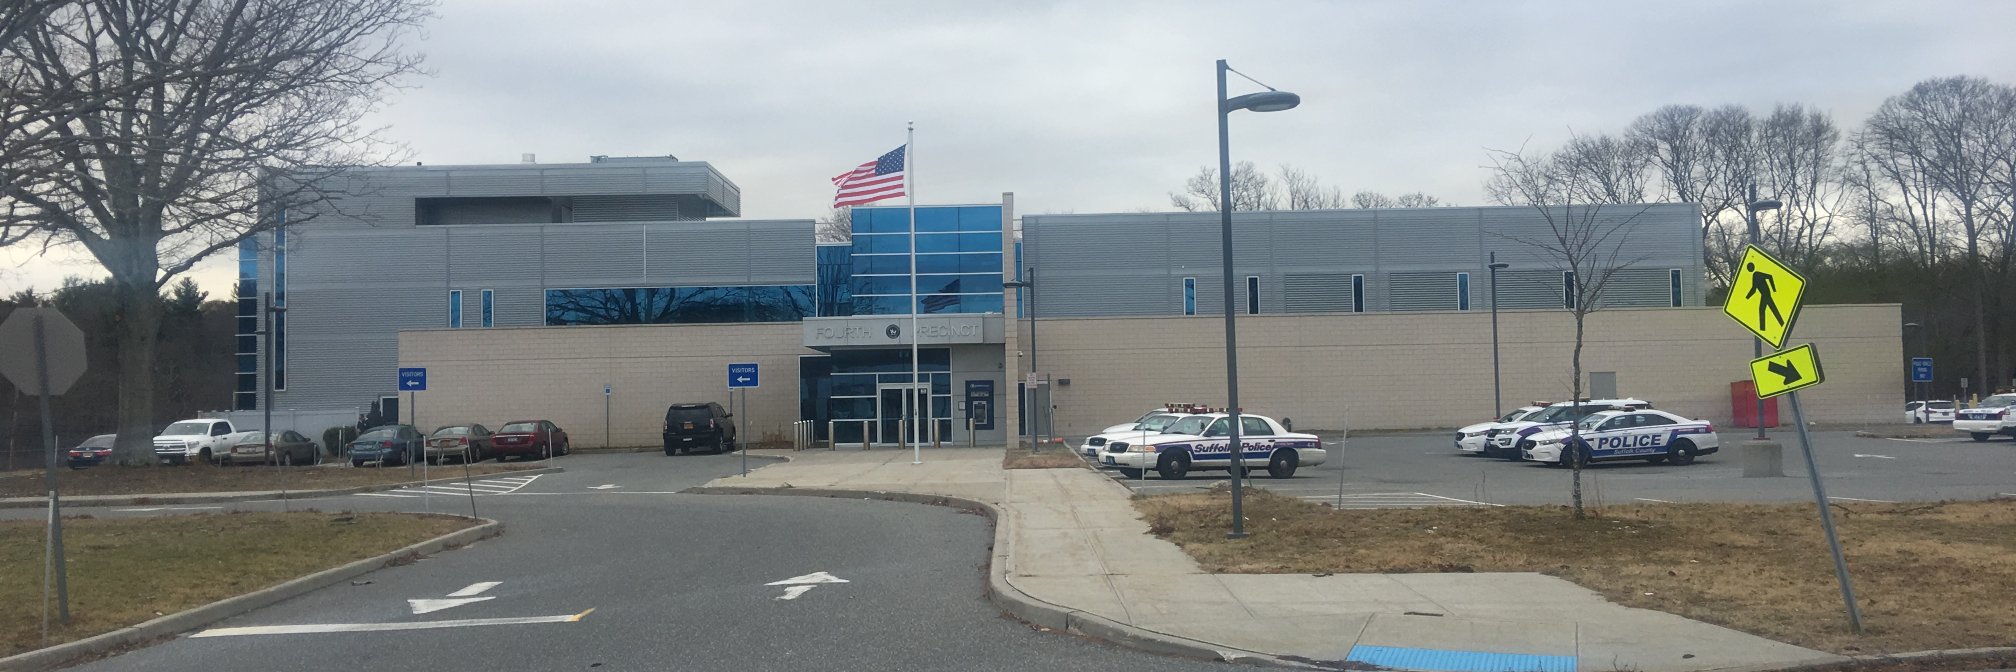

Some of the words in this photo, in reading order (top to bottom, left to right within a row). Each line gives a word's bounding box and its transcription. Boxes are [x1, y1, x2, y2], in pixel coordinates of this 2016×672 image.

[816, 327, 872, 340] FOURTH
[1241, 442, 1272, 452] Police
[1597, 434, 1662, 449] POLICE
